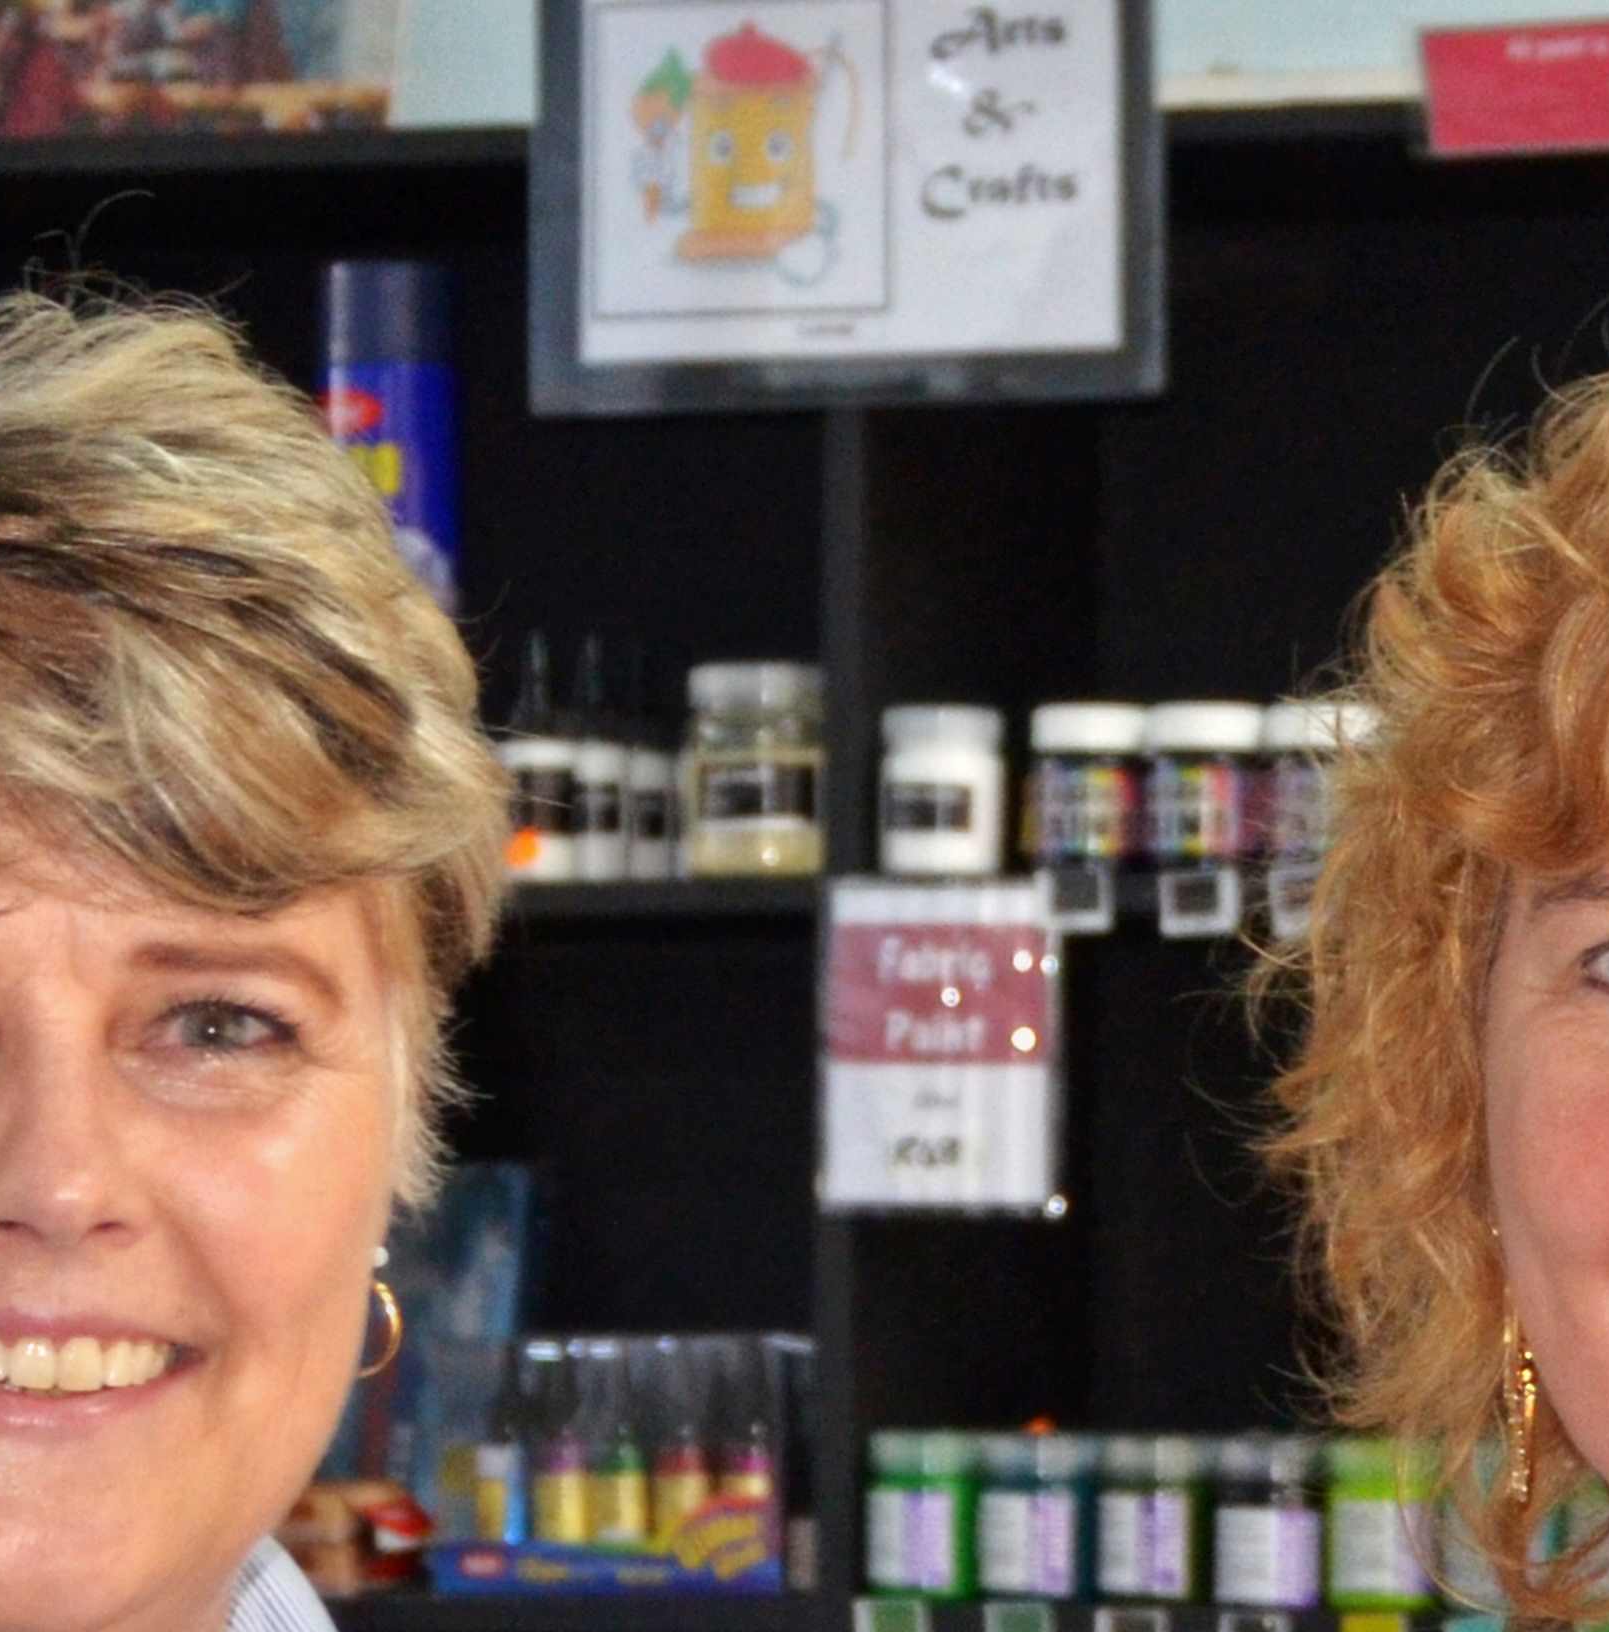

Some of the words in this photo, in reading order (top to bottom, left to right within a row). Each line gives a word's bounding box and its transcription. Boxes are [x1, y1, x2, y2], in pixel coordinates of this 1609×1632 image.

[930, 5, 1068, 61] Arts
[962, 86, 1036, 137] &
[920, 163, 1078, 220] Crafts
